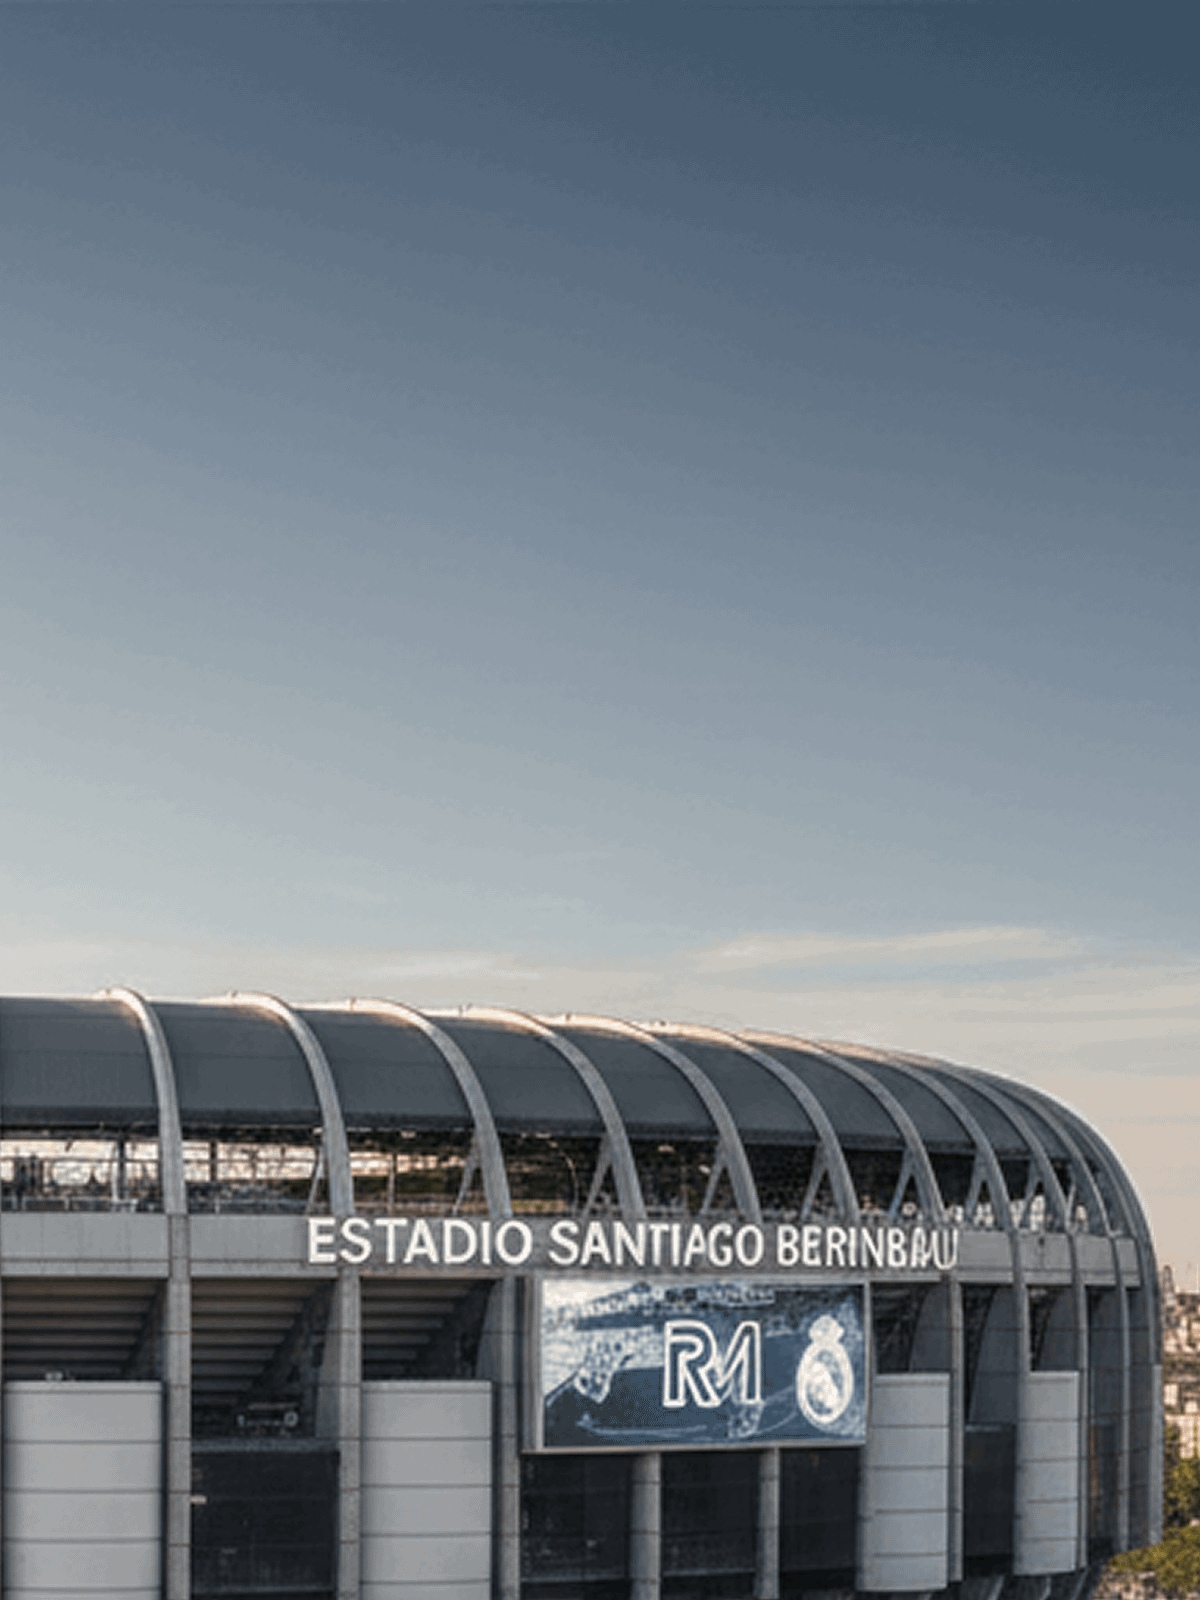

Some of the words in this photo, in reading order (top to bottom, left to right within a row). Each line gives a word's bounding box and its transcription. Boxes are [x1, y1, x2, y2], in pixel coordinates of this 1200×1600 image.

[307, 1217, 533, 1265] ESTADIO
[548, 1219, 765, 1267] SANTIAGO
[662, 1319, 761, 1408] RM
